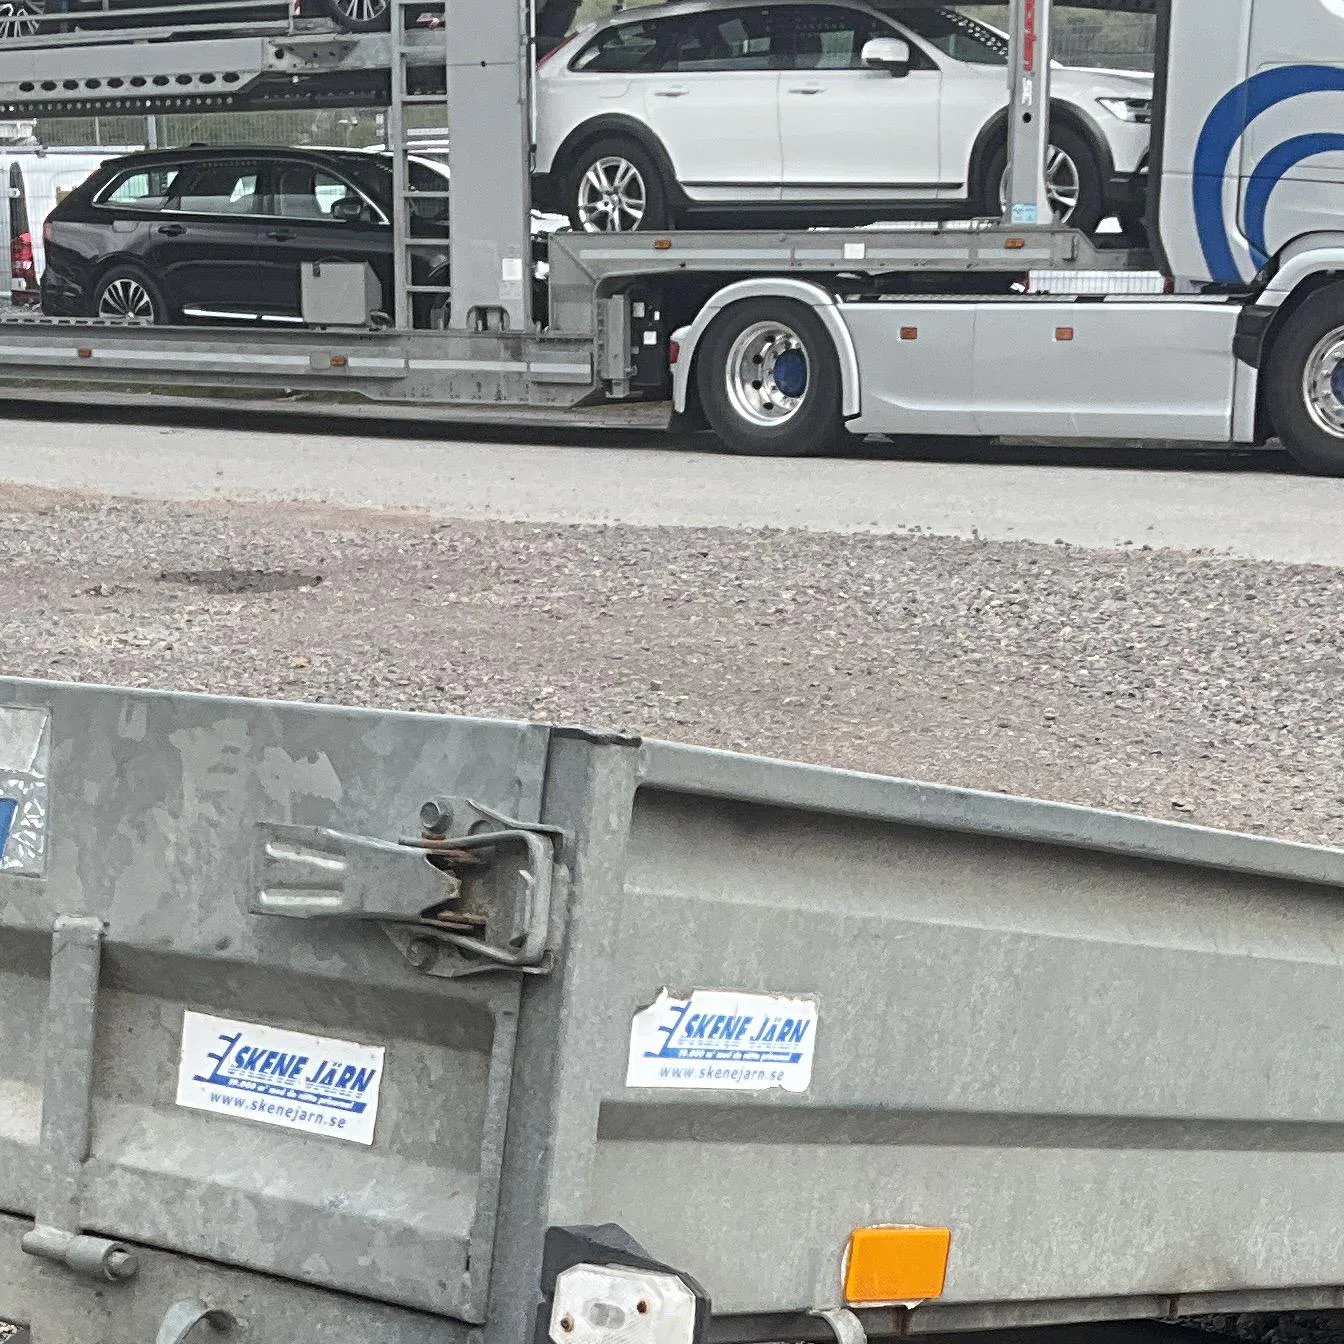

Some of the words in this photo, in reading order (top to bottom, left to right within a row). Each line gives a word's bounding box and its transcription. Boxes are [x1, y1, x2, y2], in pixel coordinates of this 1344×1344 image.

[684, 1013, 753, 1040] SKENE
[749, 1017, 810, 1043] JÄRN
[234, 1046, 309, 1079] SKENE
[306, 1060, 376, 1093] JÄRN
[660, 1066, 785, 1083] www.skenejarn.se
[210, 1091, 346, 1129] www.skenejarn.se
